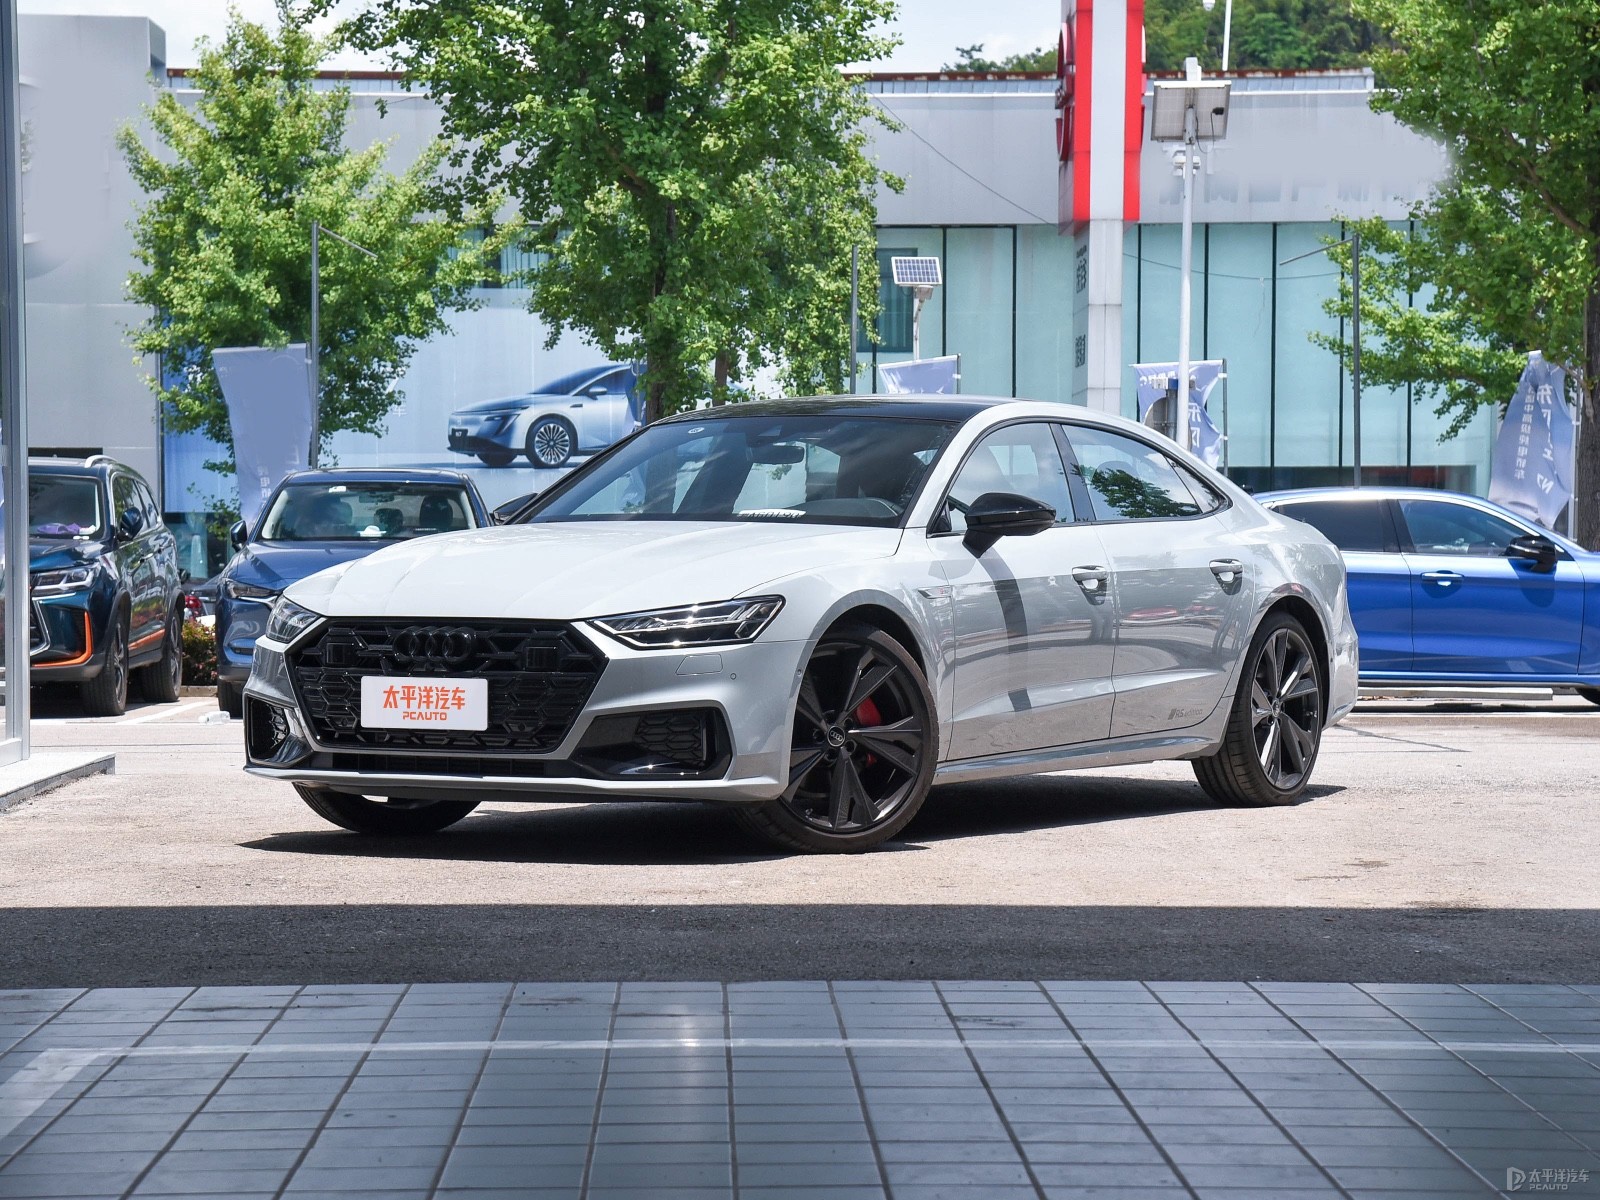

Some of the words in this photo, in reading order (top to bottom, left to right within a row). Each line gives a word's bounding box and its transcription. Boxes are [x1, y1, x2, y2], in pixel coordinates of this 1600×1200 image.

[383, 685, 466, 710] 太平洋汽车
[402, 711, 448, 721] PCAUTO
